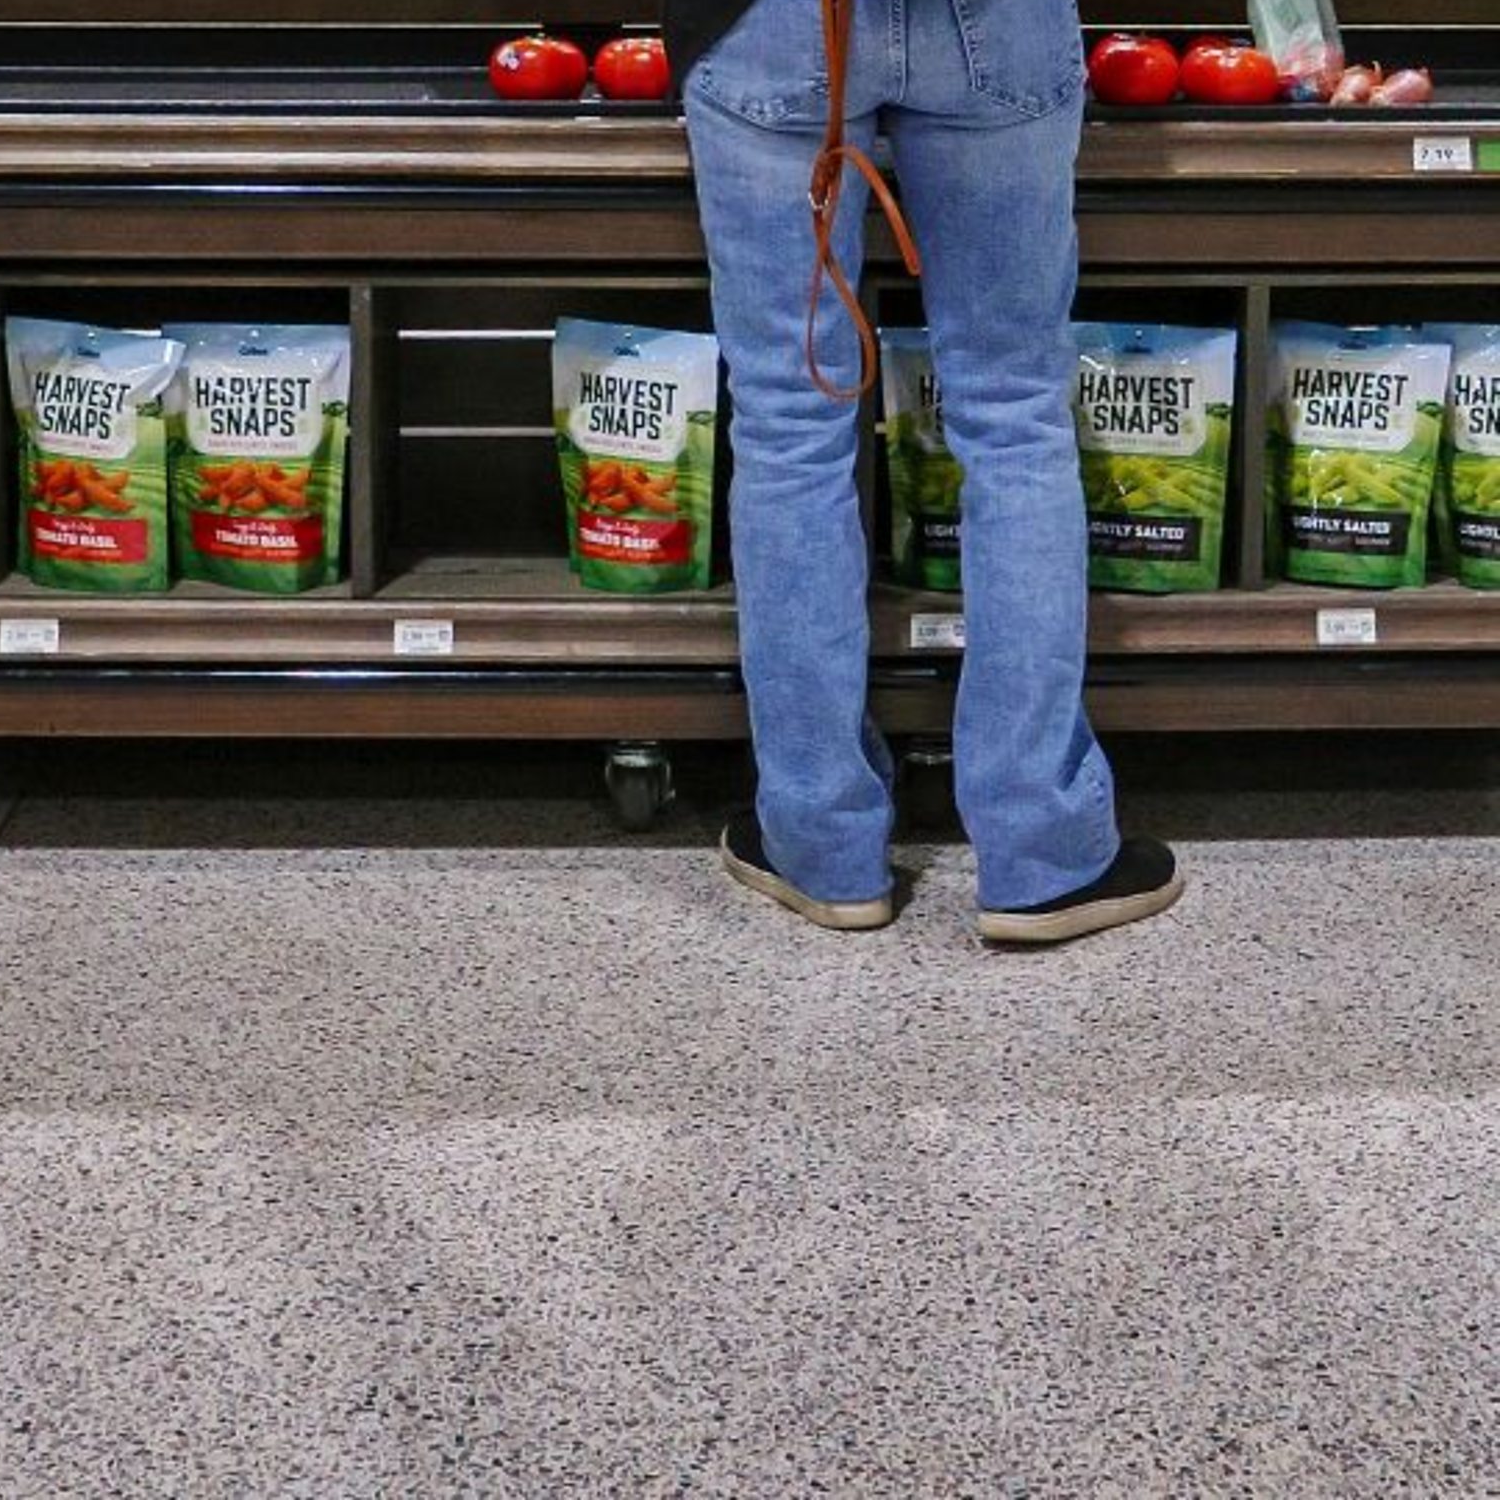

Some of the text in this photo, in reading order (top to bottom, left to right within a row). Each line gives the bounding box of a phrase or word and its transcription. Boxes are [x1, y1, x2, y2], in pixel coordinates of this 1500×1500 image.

[35, 372, 131, 413] HARVEST
[195, 376, 311, 410] HARVEST
[580, 371, 678, 415] HARVEST
[1079, 372, 1195, 409] HARVEST
[1292, 368, 1408, 406] HARVEST
[41, 404, 112, 440] SNAPS
[210, 409, 296, 437] SNAPS
[588, 405, 662, 440] SNAPS
[1093, 405, 1180, 435] SNAPS
[1305, 400, 1390, 430] SNAPS
